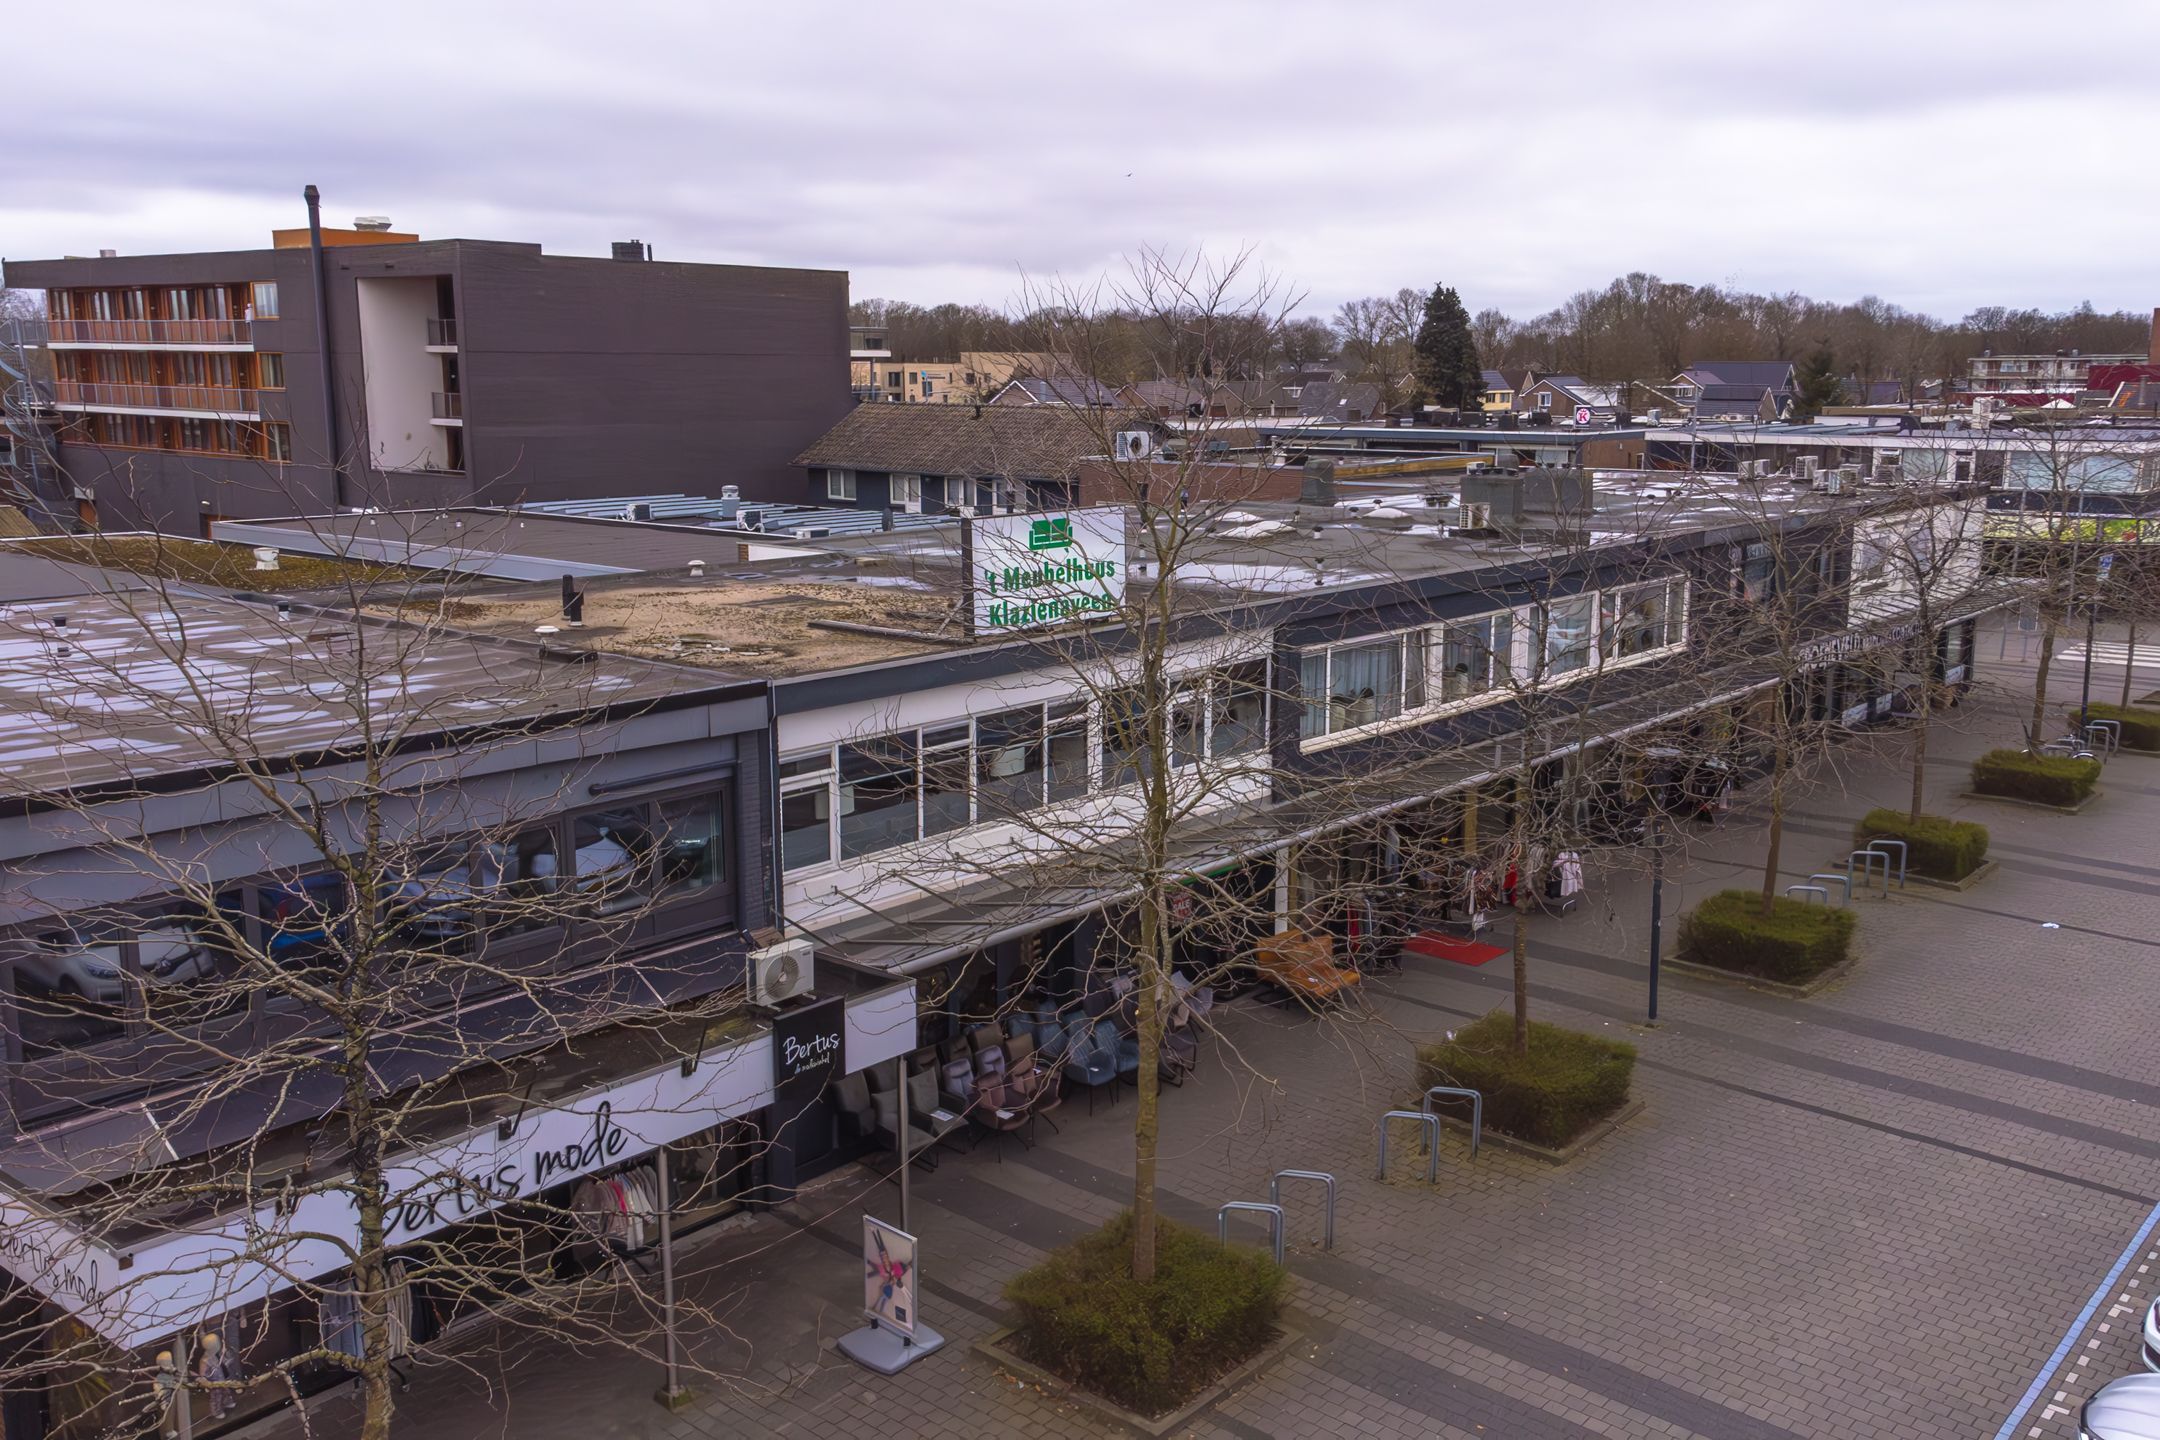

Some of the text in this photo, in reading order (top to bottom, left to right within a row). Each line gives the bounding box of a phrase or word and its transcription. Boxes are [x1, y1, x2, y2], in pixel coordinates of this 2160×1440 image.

[1579, 412, 1588, 422] K
[1004, 558, 1116, 592] Meubelhuus
[989, 594, 1114, 627] Klazienaveen
[782, 1033, 841, 1065] Bertus
[535, 1100, 629, 1184] mode
[63, 1259, 109, 1315] mode
